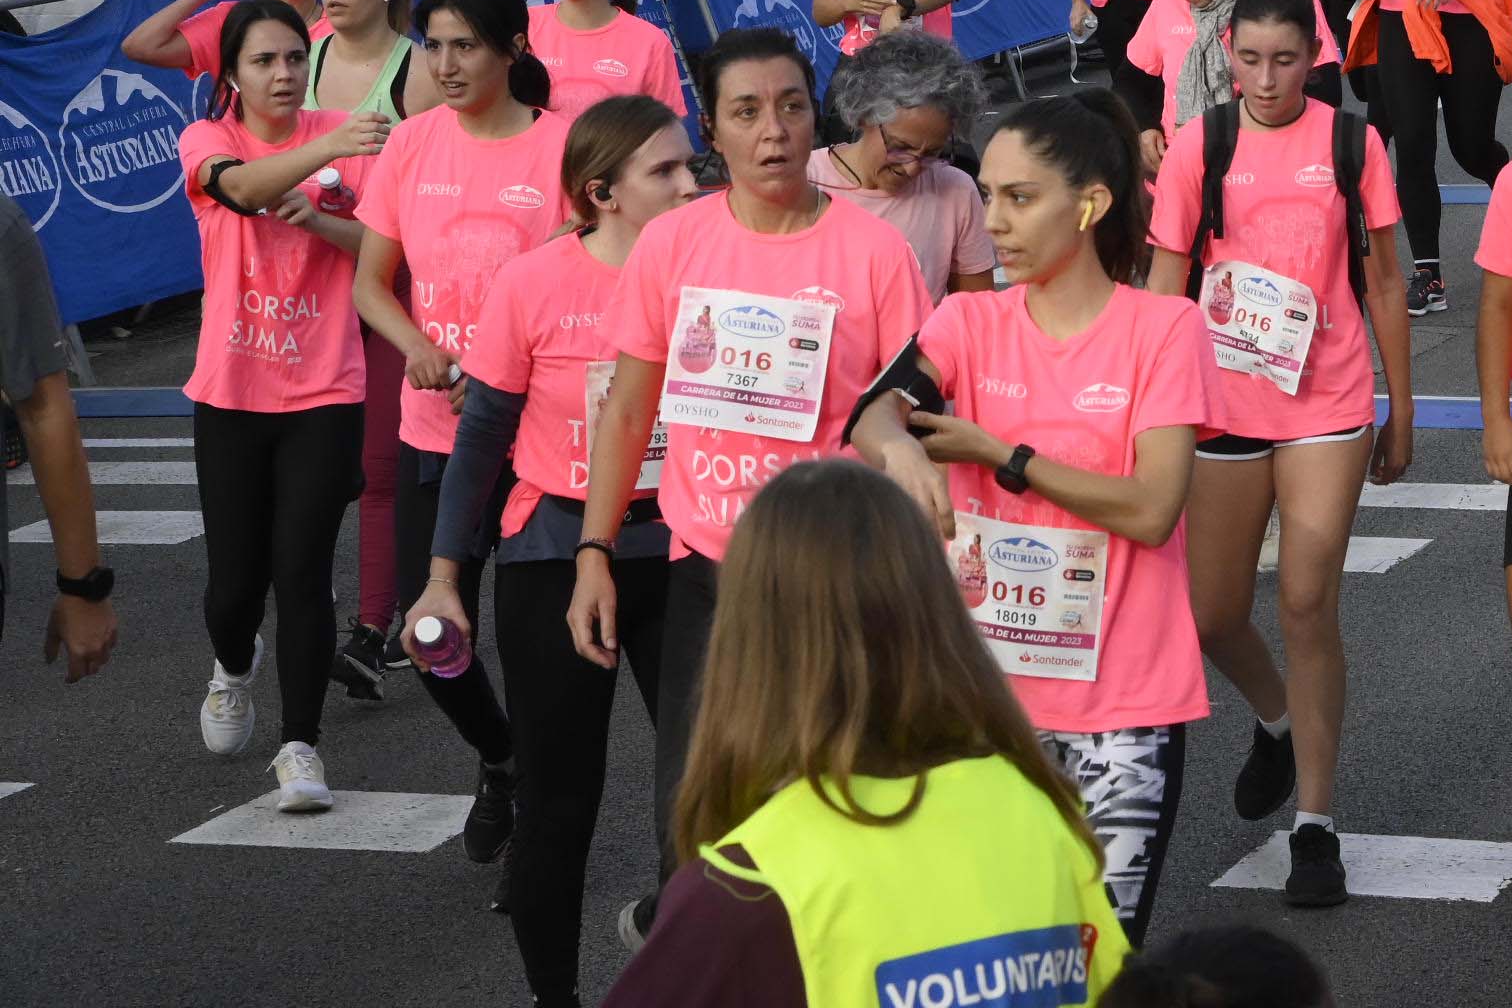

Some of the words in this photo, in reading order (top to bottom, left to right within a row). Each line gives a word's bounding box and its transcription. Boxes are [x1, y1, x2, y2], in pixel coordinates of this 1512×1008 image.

[1225, 172, 1255, 185] SHO
[500, 190, 545, 208] ASTURIANA
[1240, 282, 1281, 305] ASTURIANA
[235, 289, 321, 321] ORSAL
[719, 314, 780, 335] ASTURIANA
[791, 319, 821, 331] SUMA
[1233, 307, 1272, 333] 016
[720, 346, 773, 371] 016
[1216, 350, 1236, 363] SHO
[726, 373, 759, 388] 7367
[680, 385, 721, 398] CARRERA
[722, 391, 735, 401] DE
[737, 393, 749, 402] LA
[750, 395, 782, 407] MUJER
[1076, 393, 1126, 408] ASTURIANA
[674, 403, 719, 419] OYSHO
[757, 415, 804, 431] Santander
[990, 545, 1054, 567] ASTURIANA
[1064, 548, 1096, 560] SUMA
[991, 580, 1046, 607] 016
[994, 608, 1038, 626] 18019
[996, 628, 1009, 639] DE
[1009, 630, 1022, 641] LA
[1024, 632, 1058, 644] MUJER
[1060, 634, 1083, 646] 2023
[1031, 653, 1084, 668] Santander
